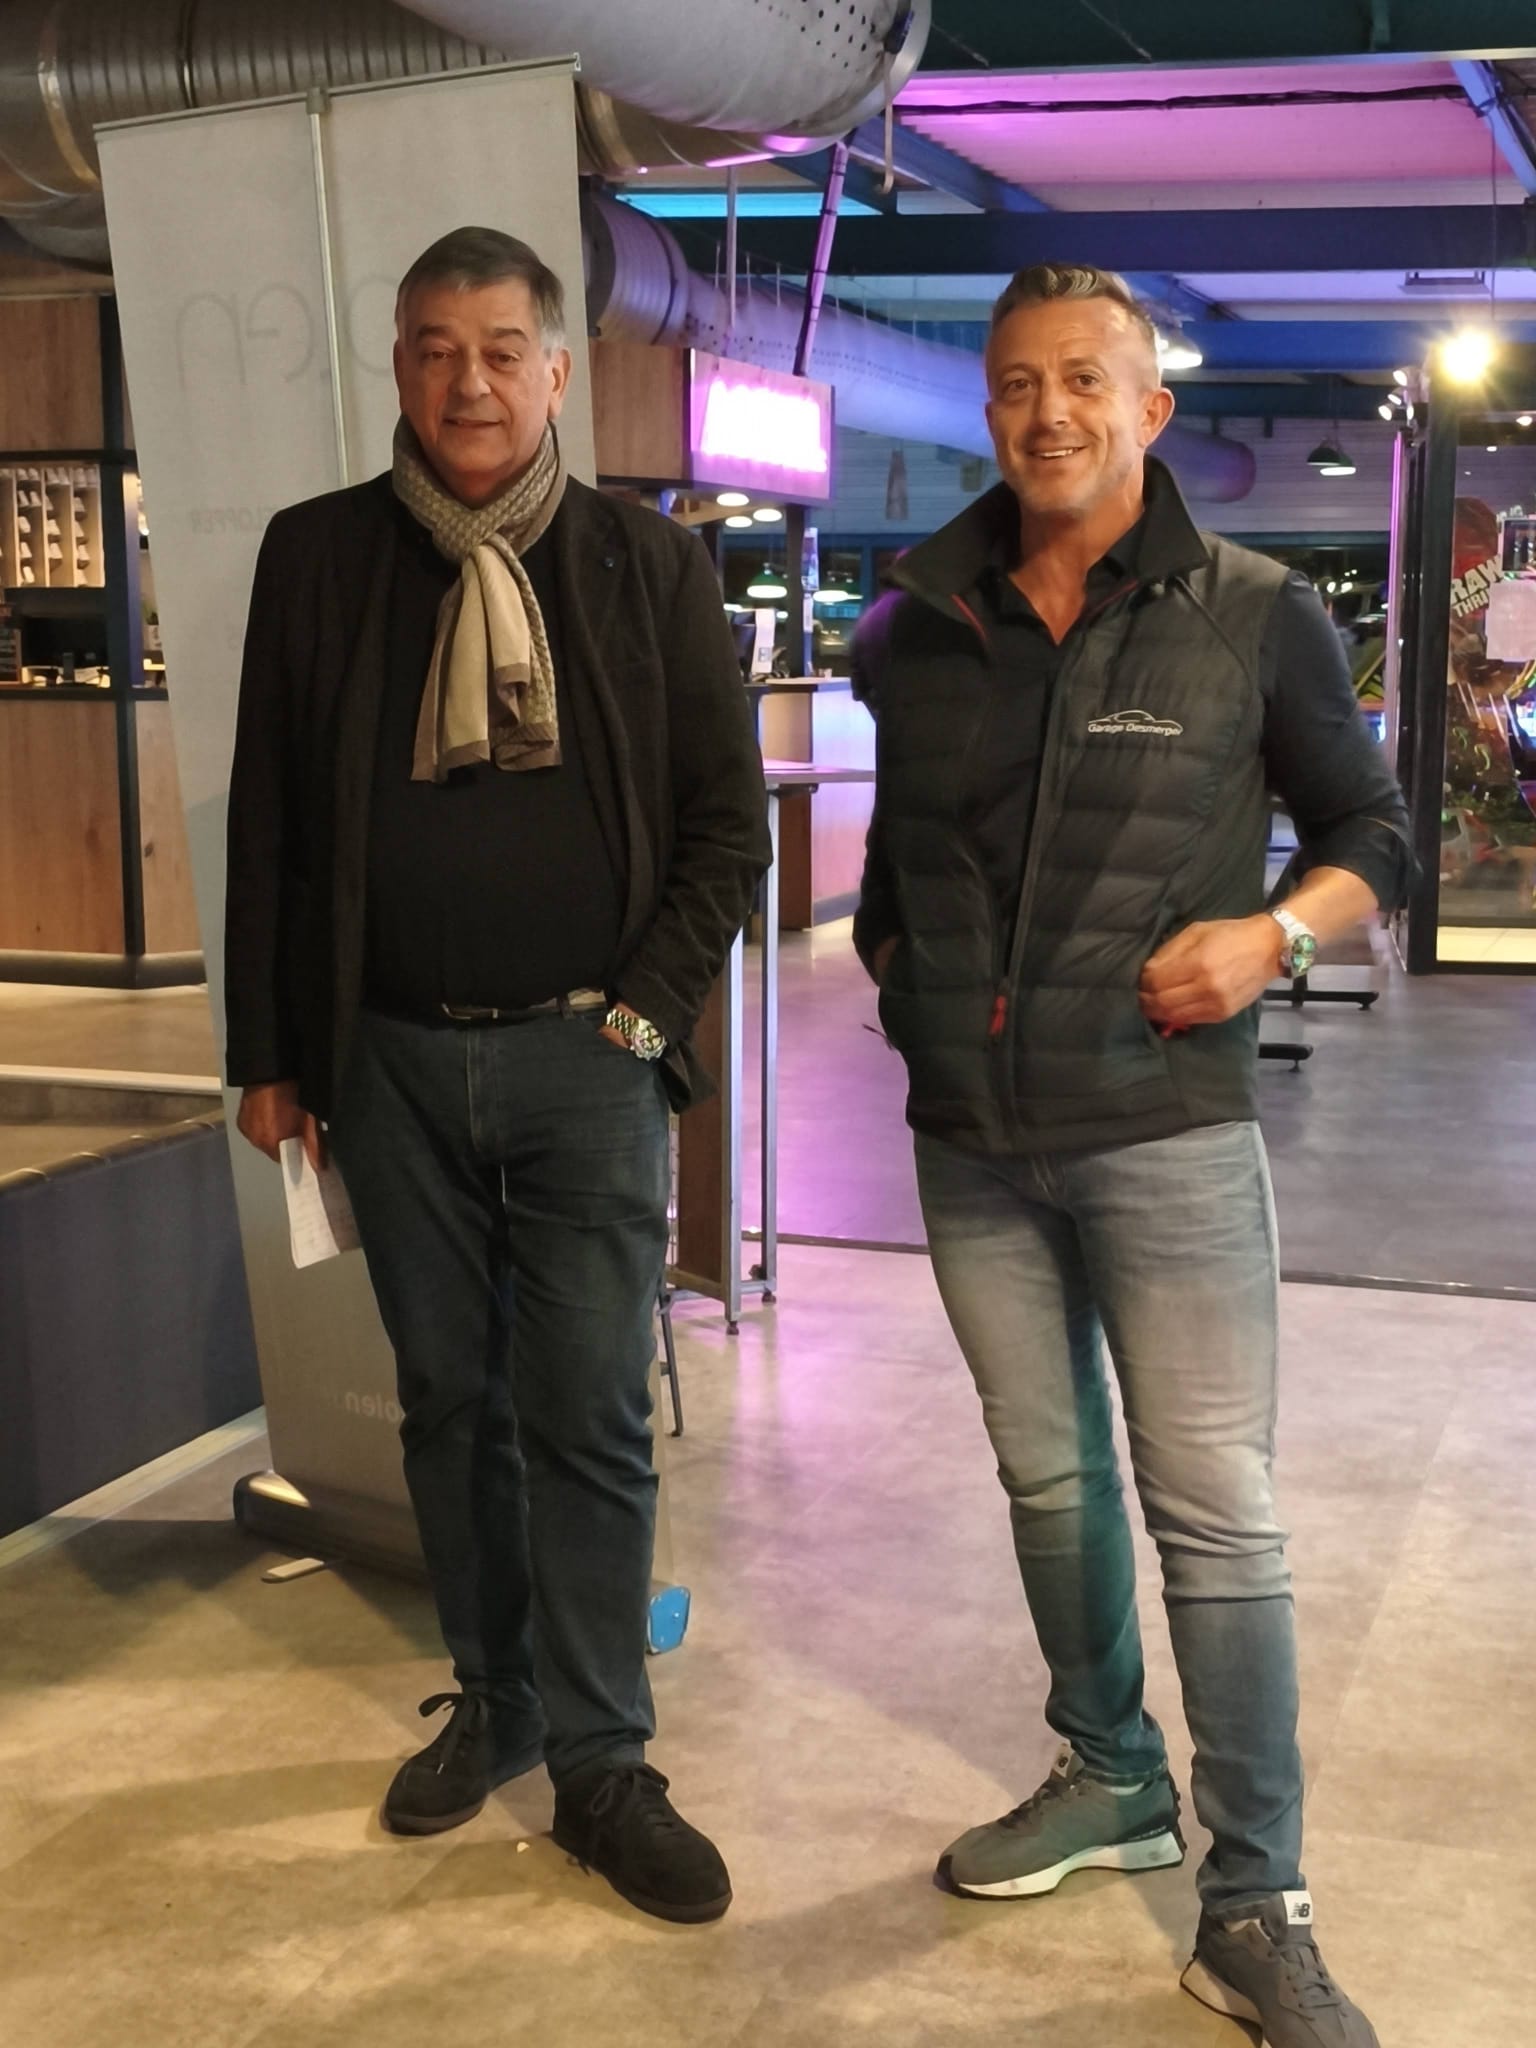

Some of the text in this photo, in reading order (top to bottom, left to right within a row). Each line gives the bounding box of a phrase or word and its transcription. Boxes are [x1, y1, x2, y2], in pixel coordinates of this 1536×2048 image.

[1451, 554, 1503, 605] RAW
[1453, 588, 1490, 618] THRI
[1088, 724, 1124, 734] Garage
